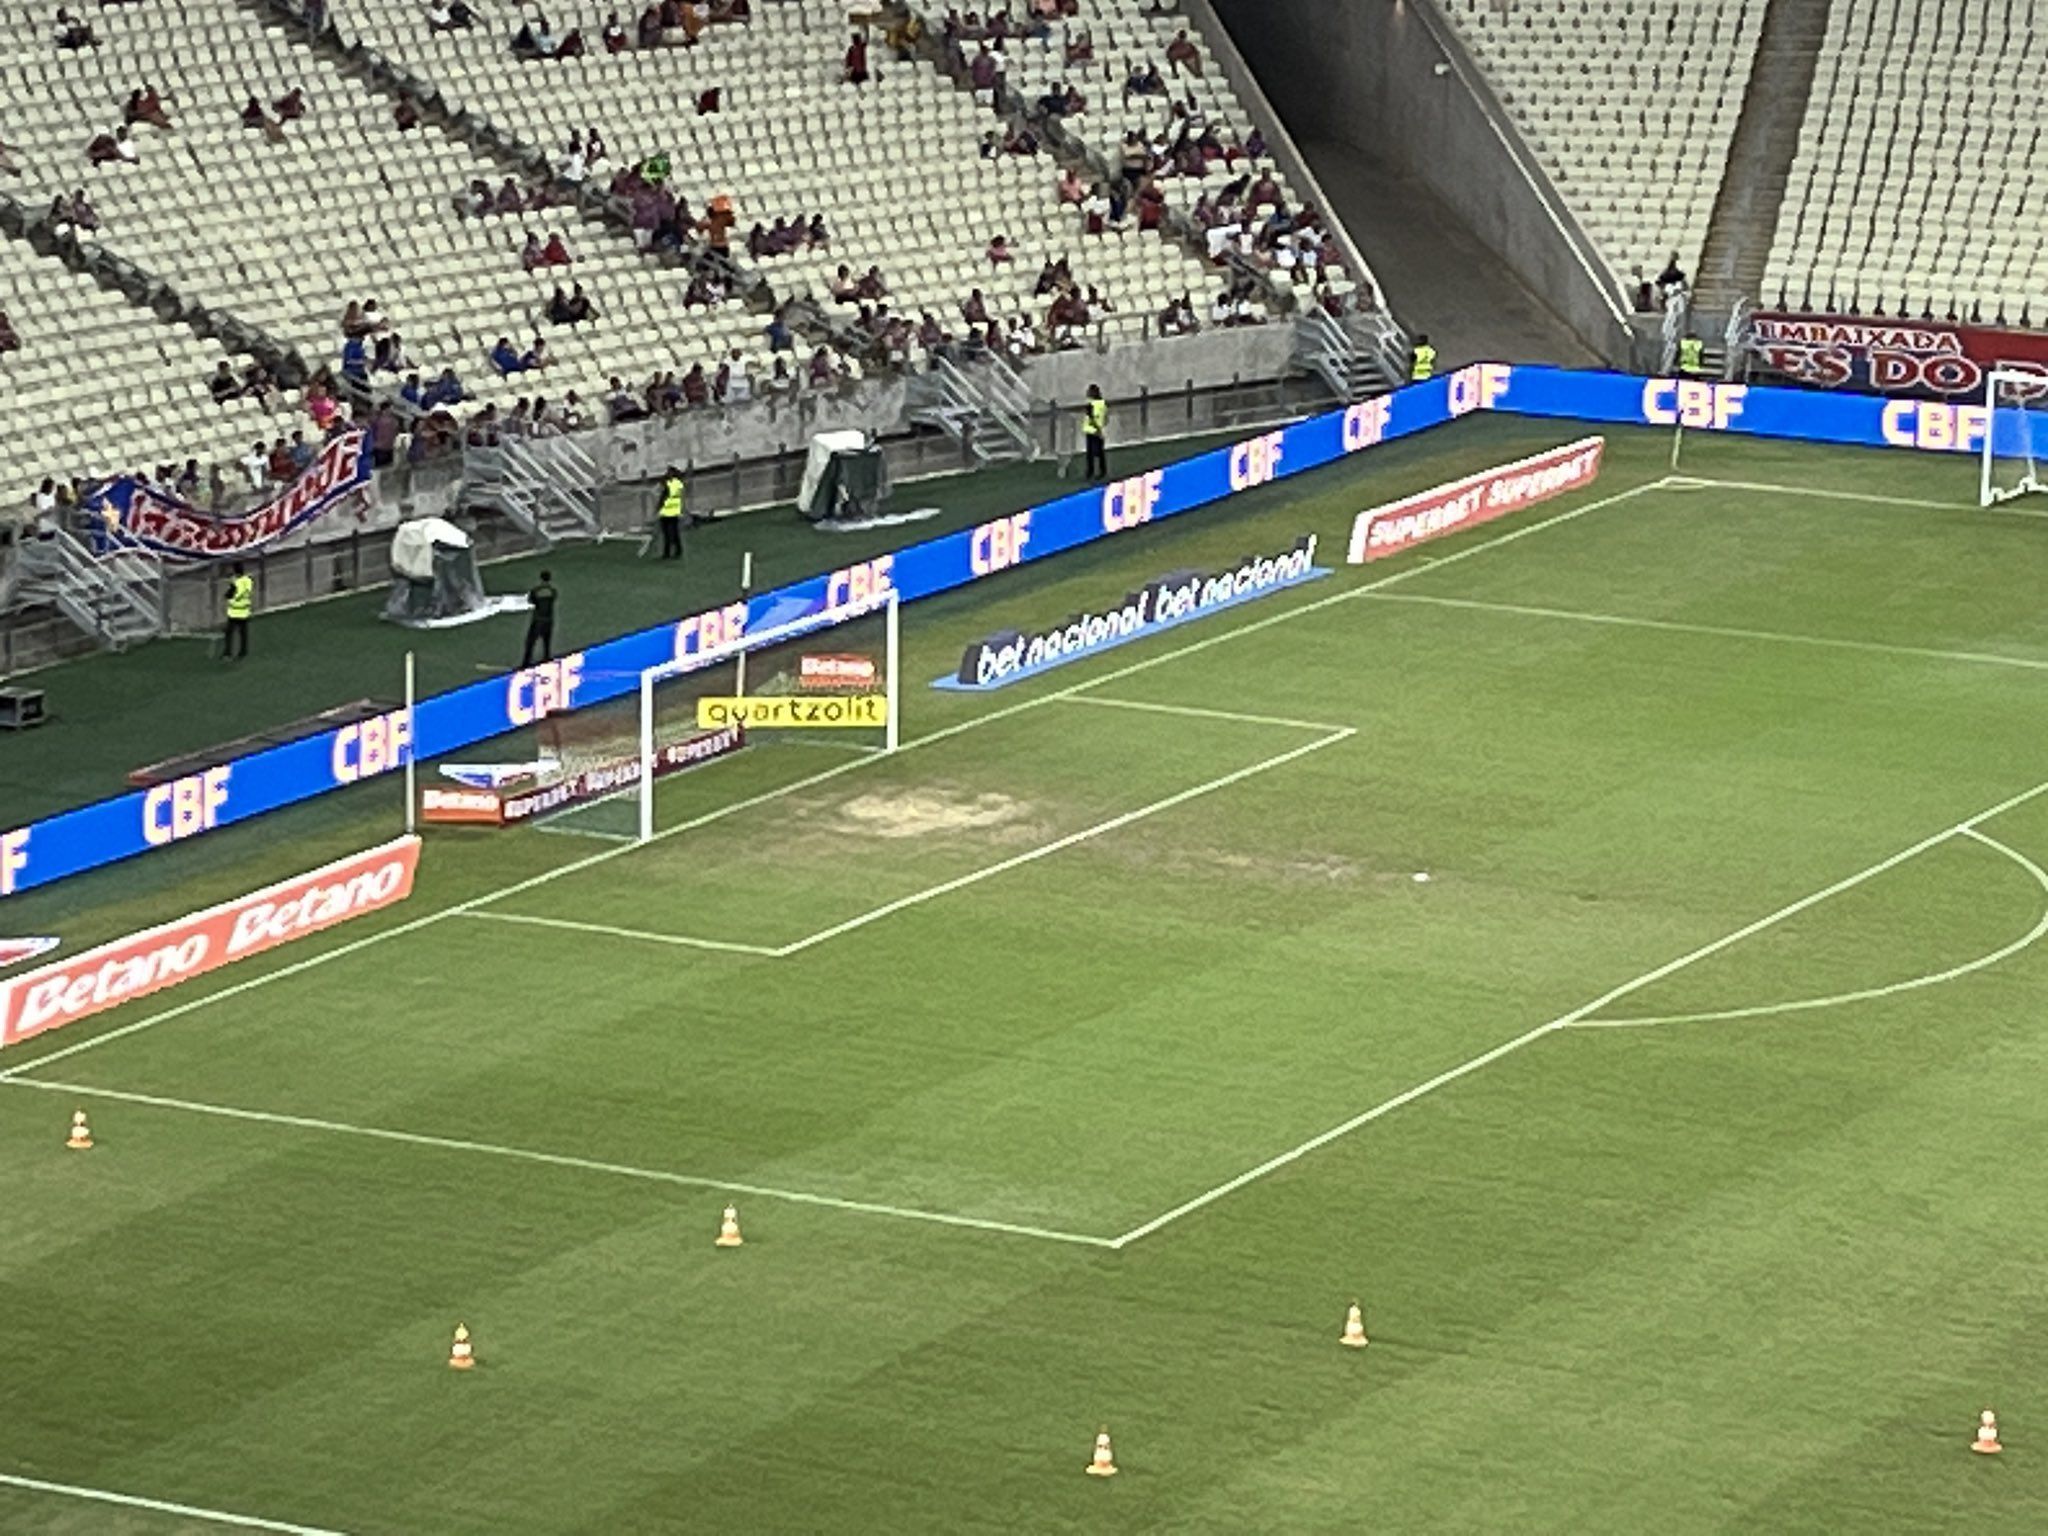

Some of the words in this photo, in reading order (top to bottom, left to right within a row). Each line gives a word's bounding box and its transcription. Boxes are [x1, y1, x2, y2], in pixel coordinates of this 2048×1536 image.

[1868, 350, 1982, 393] DO
[1343, 394, 1392, 452] CBF
[1643, 379, 1748, 430] CBF
[1882, 400, 1988, 451] CBF
[1231, 430, 1283, 491] CBF
[1103, 469, 1162, 533] CBF
[971, 510, 1031, 577] CBF
[977, 634, 1026, 685] bet
[1026, 590, 1149, 667] nacional
[1155, 577, 1200, 623] bet
[508, 652, 584, 725] CBF
[707, 695, 879, 724] quartzolit
[333, 707, 412, 783] CBF
[143, 766, 231, 843] CBF
[15, 934, 209, 1032] Betano
[226, 860, 404, 955] Betano
